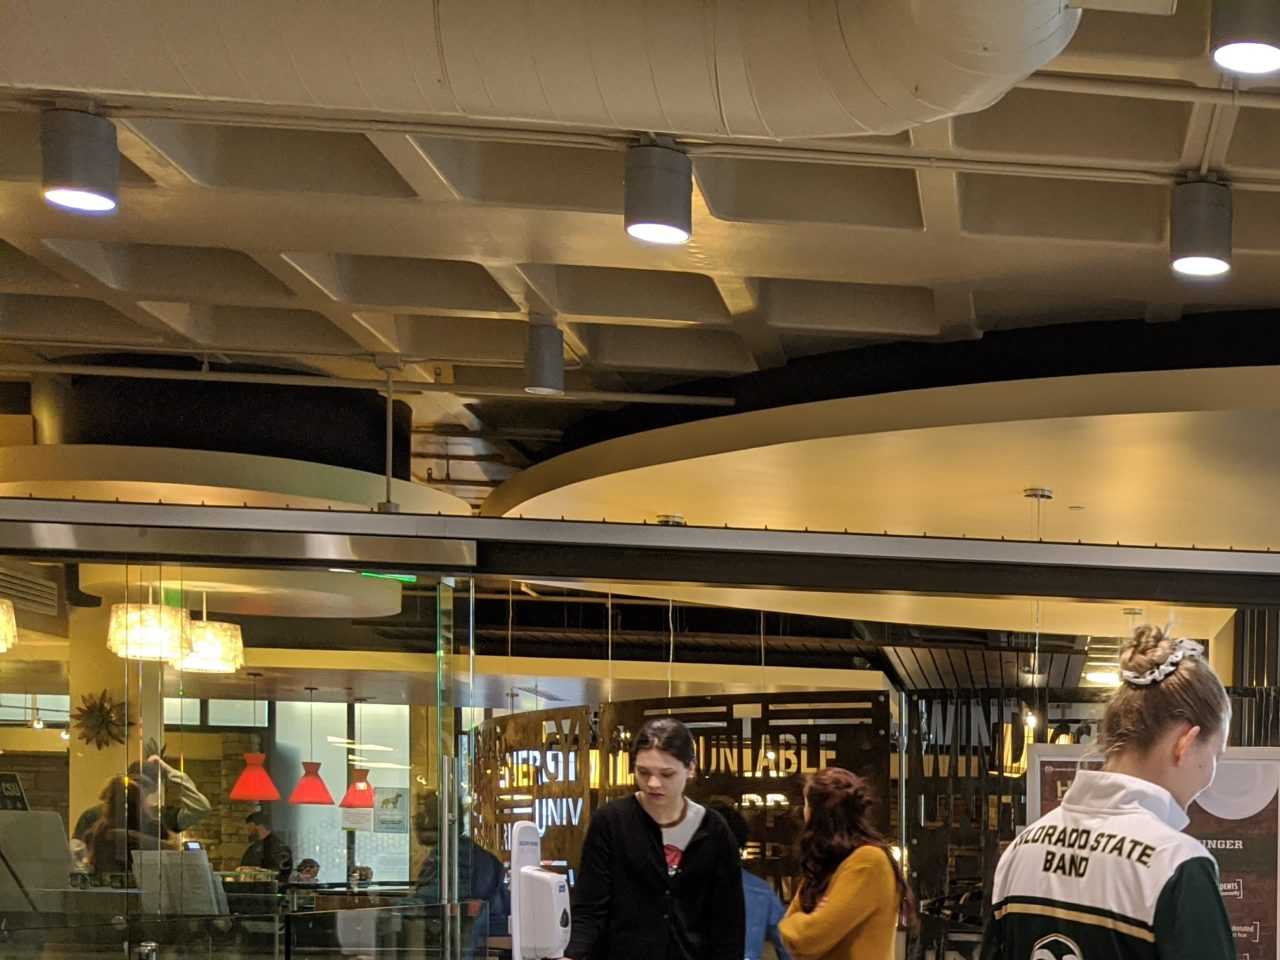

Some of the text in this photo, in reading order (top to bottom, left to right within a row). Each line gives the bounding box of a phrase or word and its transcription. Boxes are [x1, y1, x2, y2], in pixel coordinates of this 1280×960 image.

[1014, 825, 1156, 867] OLORADO STATE
[1042, 850, 1089, 877] BAND
